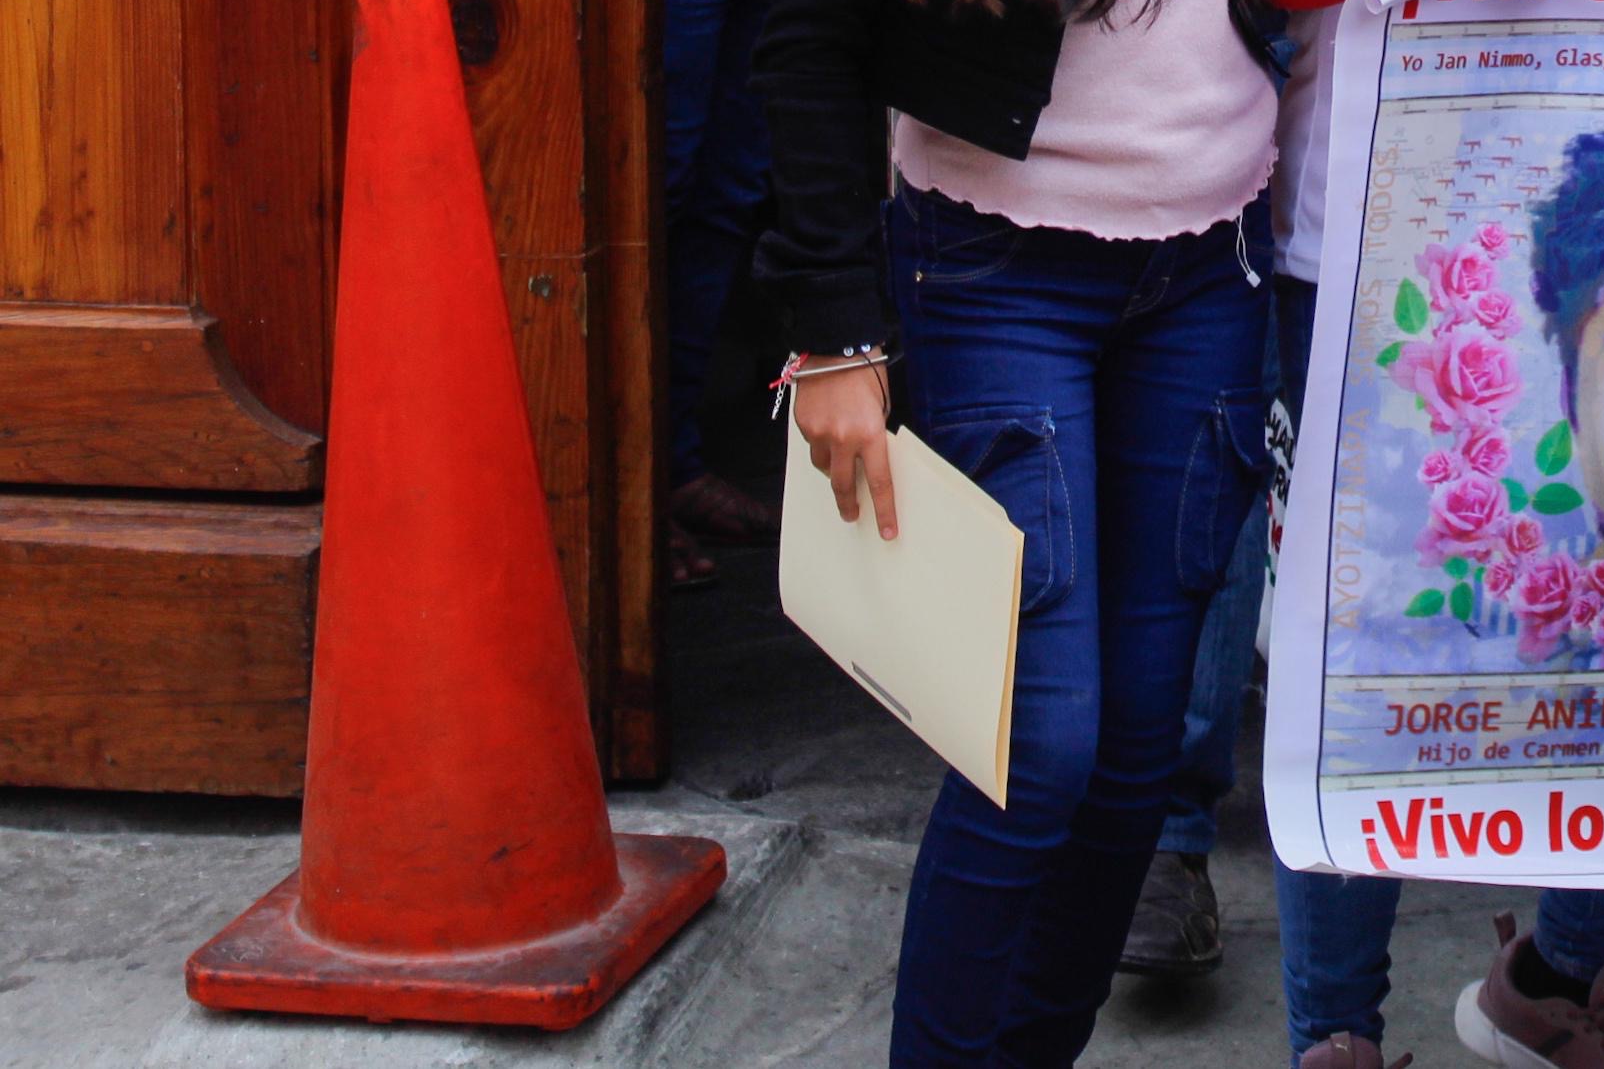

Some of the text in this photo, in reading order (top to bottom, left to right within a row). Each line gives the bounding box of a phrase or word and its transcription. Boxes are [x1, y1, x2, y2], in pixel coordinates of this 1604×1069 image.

[1402, 54, 1424, 72] Yo
[1435, 53, 1467, 71] Jan
[1478, 50, 1542, 71] Nimmo,
[1331, 407, 1371, 632] AYOTZINAPA
[1385, 701, 1503, 736] JORGE
[1418, 742, 1472, 766] Hijo
[1484, 742, 1511, 760] de
[1523, 740, 1601, 759] Carmen
[1361, 796, 1524, 871] ¡Vivo
[1548, 791, 1604, 852] lo
